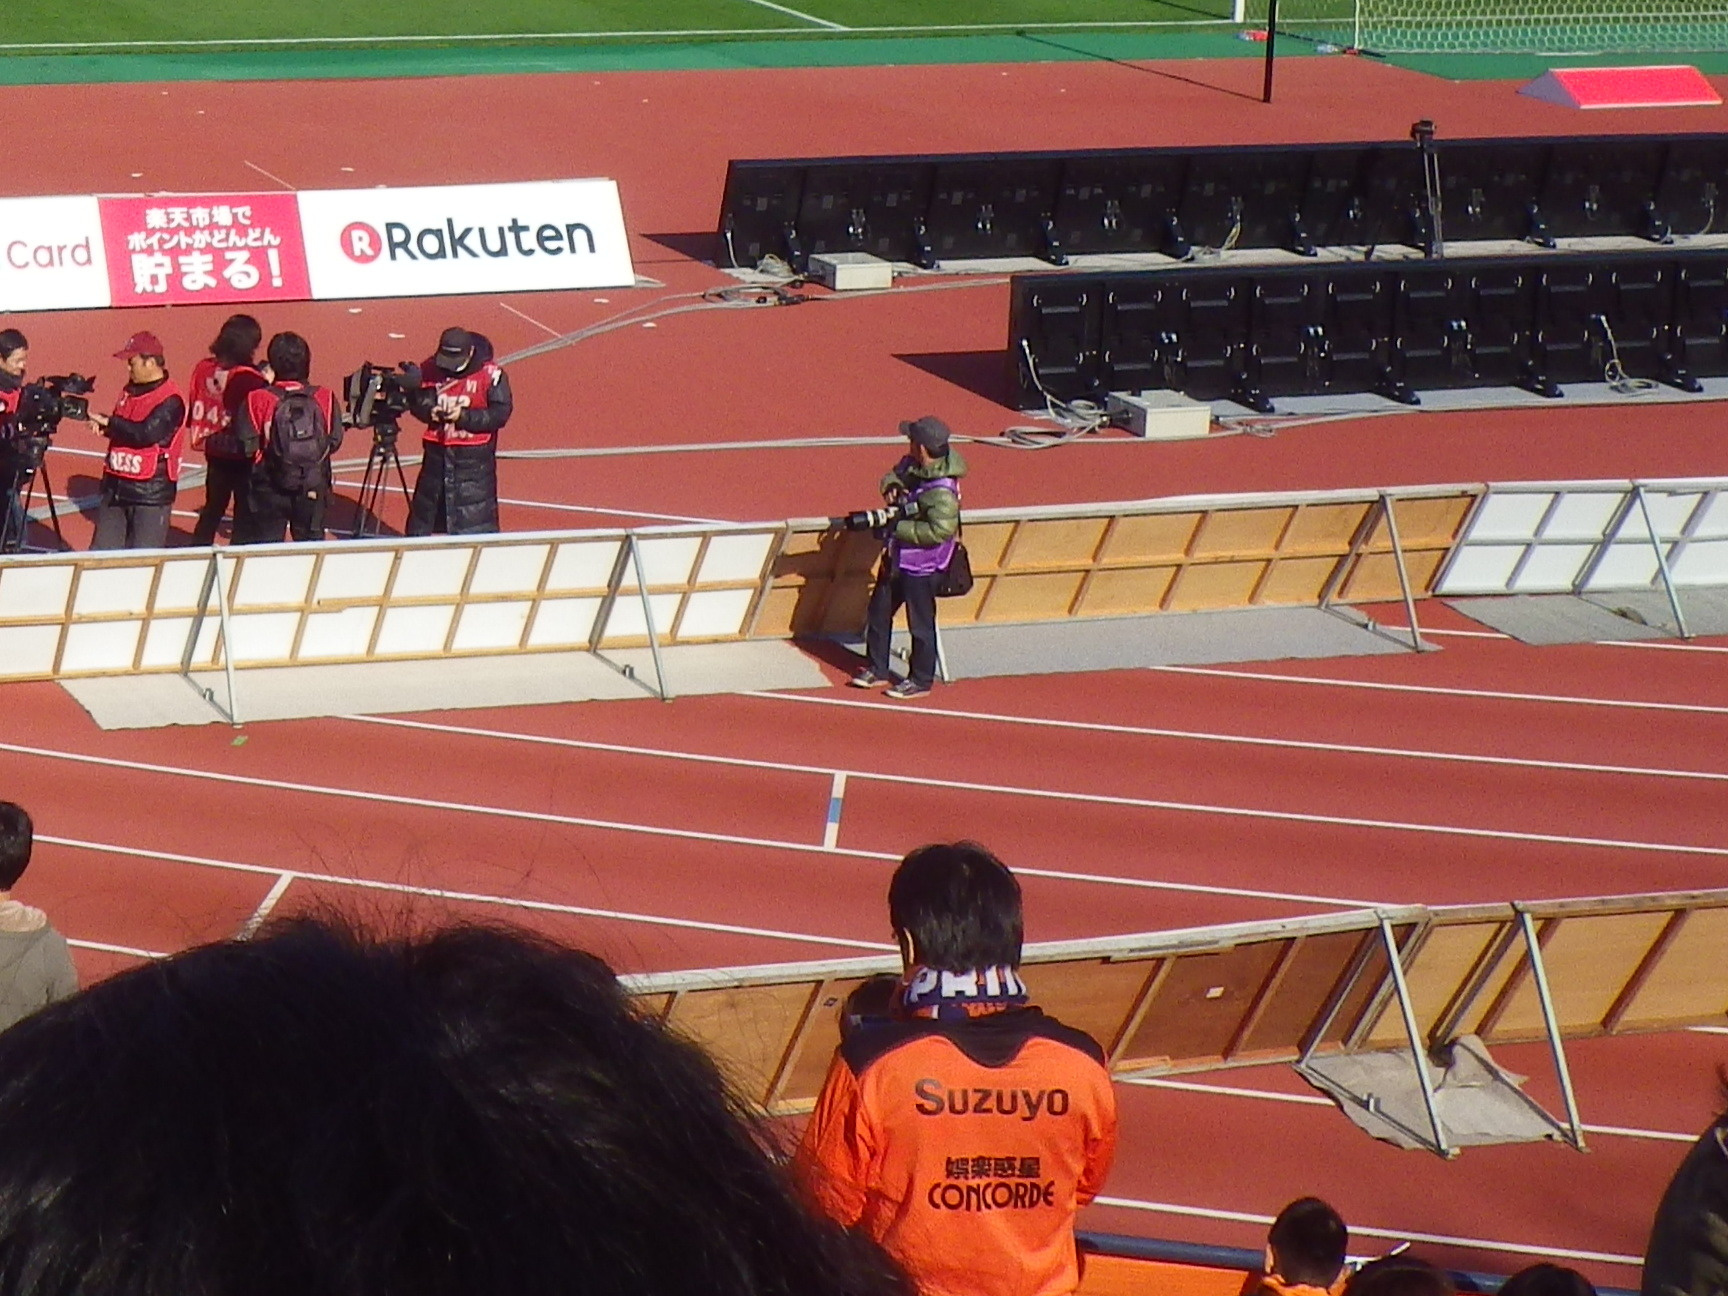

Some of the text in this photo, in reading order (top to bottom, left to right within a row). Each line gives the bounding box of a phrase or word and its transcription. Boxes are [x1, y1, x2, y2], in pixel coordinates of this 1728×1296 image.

[144, 204, 252, 229] 楽天市場で
[6, 236, 93, 270] Card
[127, 227, 282, 251] ポイントがどんどん
[385, 217, 596, 261] Rakuten
[914, 1077, 1070, 1122] Suzuyo
[927, 1179, 1055, 1212] CONCORDE
